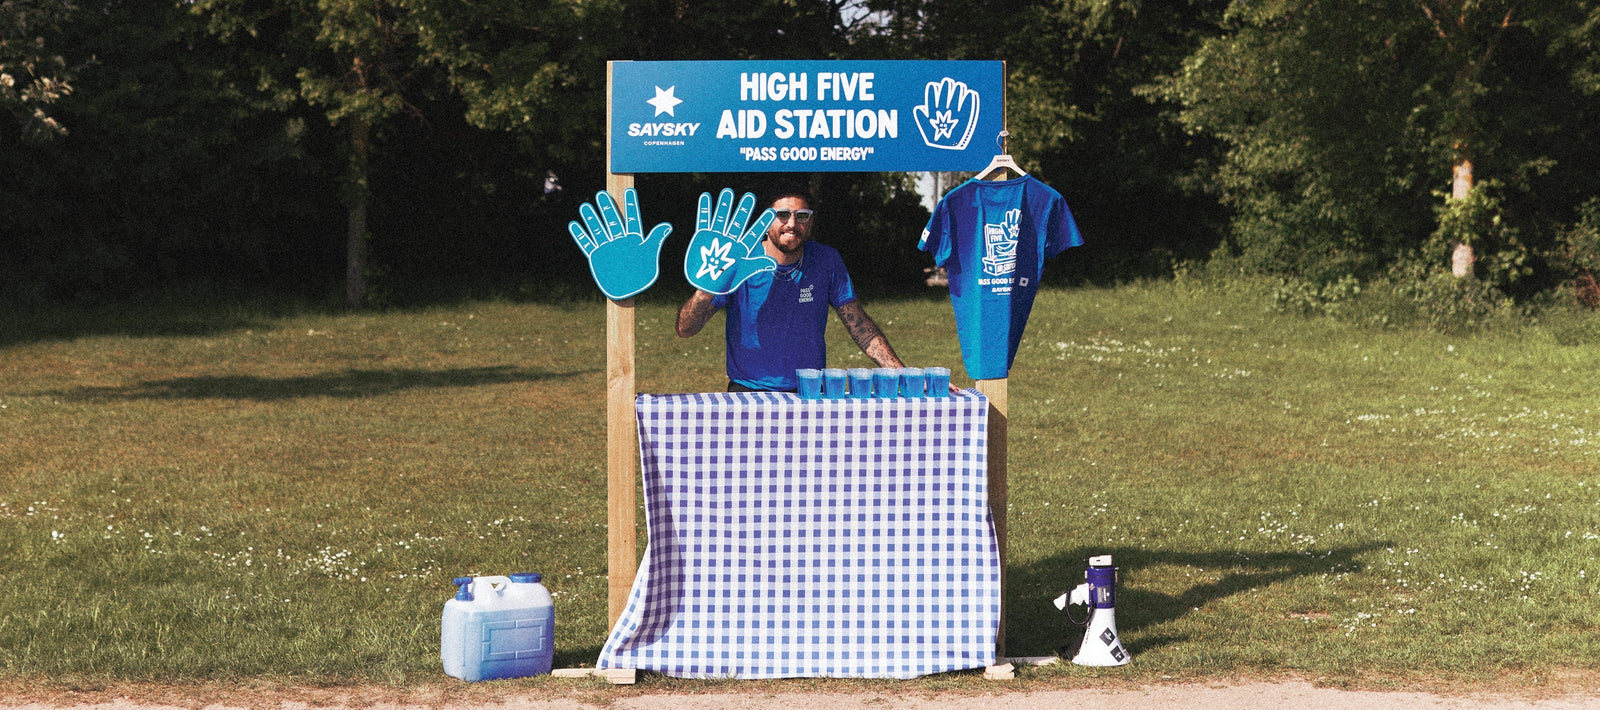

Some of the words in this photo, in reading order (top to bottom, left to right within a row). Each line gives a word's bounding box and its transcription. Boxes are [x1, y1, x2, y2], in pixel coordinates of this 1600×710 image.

[740, 72, 808, 101] HIGH
[817, 72, 875, 101] FIVE
[627, 122, 701, 137] SAYSKY
[716, 109, 768, 139] AID
[774, 109, 898, 139] STATION
[740, 147, 778, 161] "PASS
[780, 147, 818, 161] GOOD
[820, 147, 874, 161] ENERGY"
